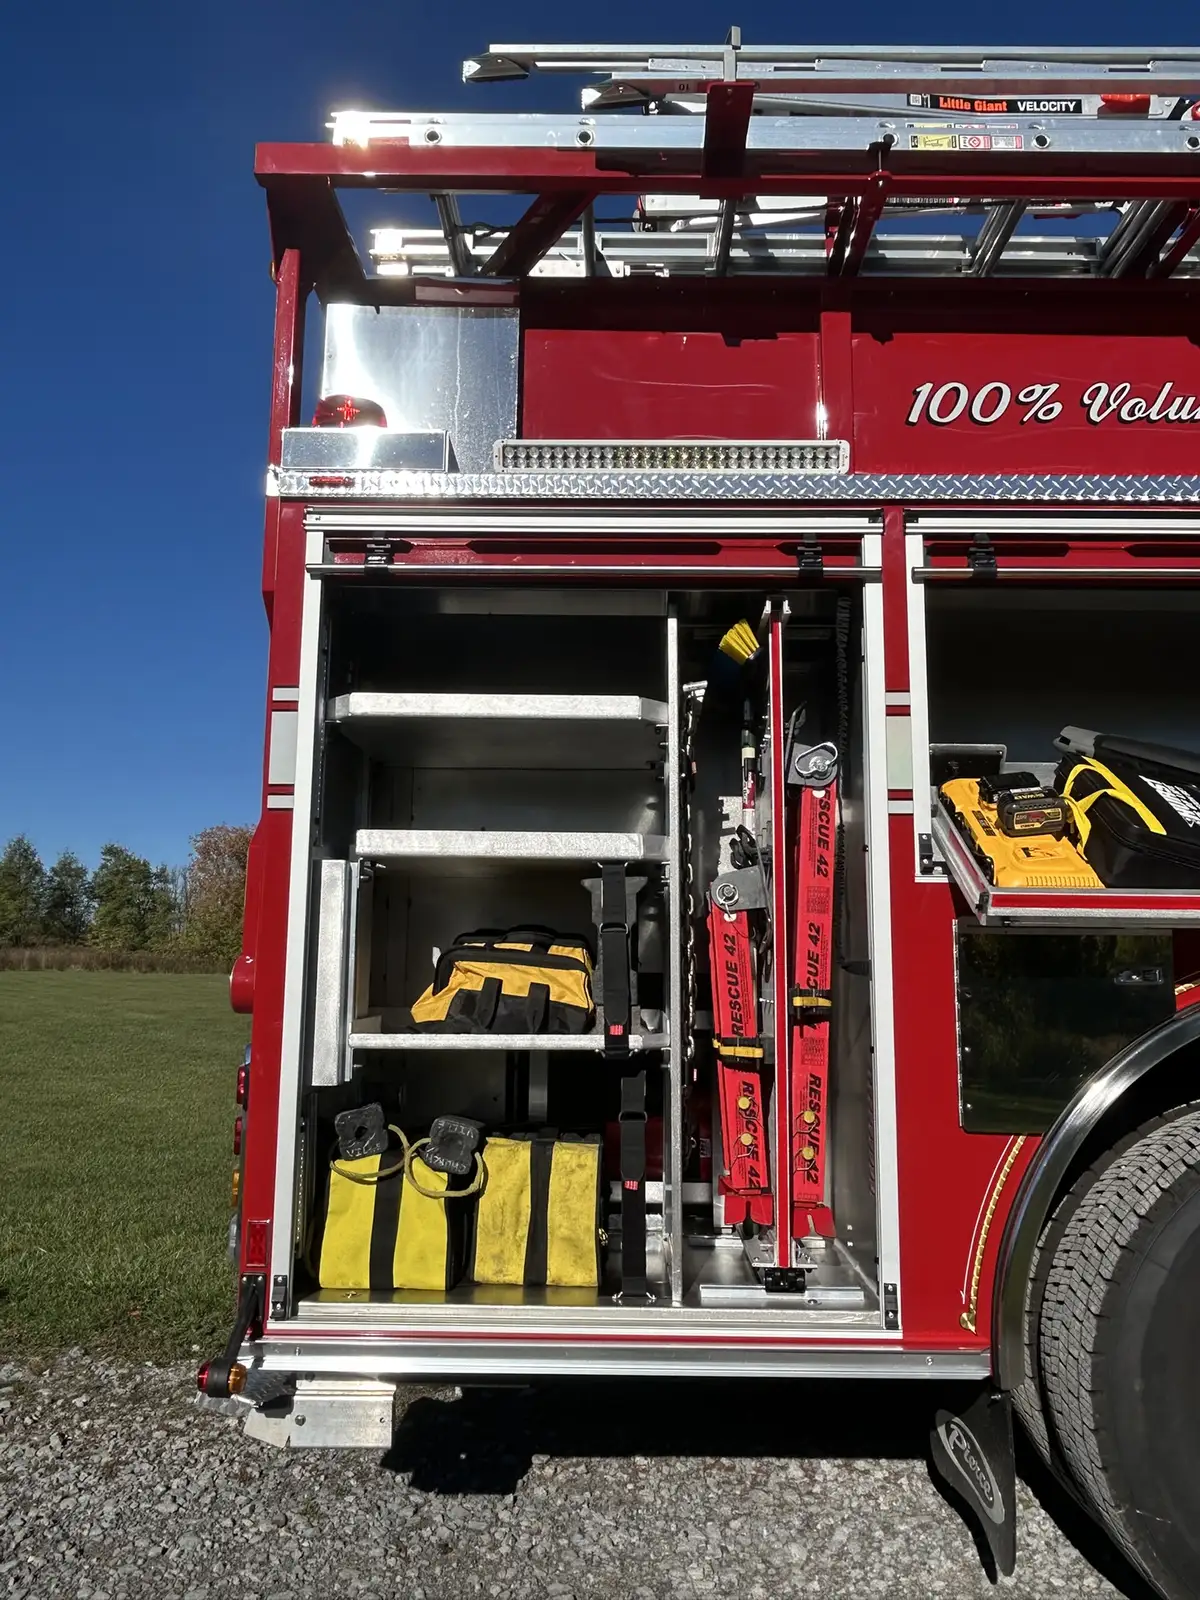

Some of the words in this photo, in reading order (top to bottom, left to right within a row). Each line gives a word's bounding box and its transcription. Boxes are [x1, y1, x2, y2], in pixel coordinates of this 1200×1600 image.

[939, 97, 971, 111] Little
[974, 99, 1008, 112] Giant
[1017, 101, 1077, 112] VELOCITY
[906, 381, 1064, 426] 100%
[816, 859, 830, 879] 42
[808, 922, 822, 943] 42
[723, 933, 737, 956] 42
[725, 960, 744, 1037] RESCUE
[949, 1423, 994, 1502] Pierce
